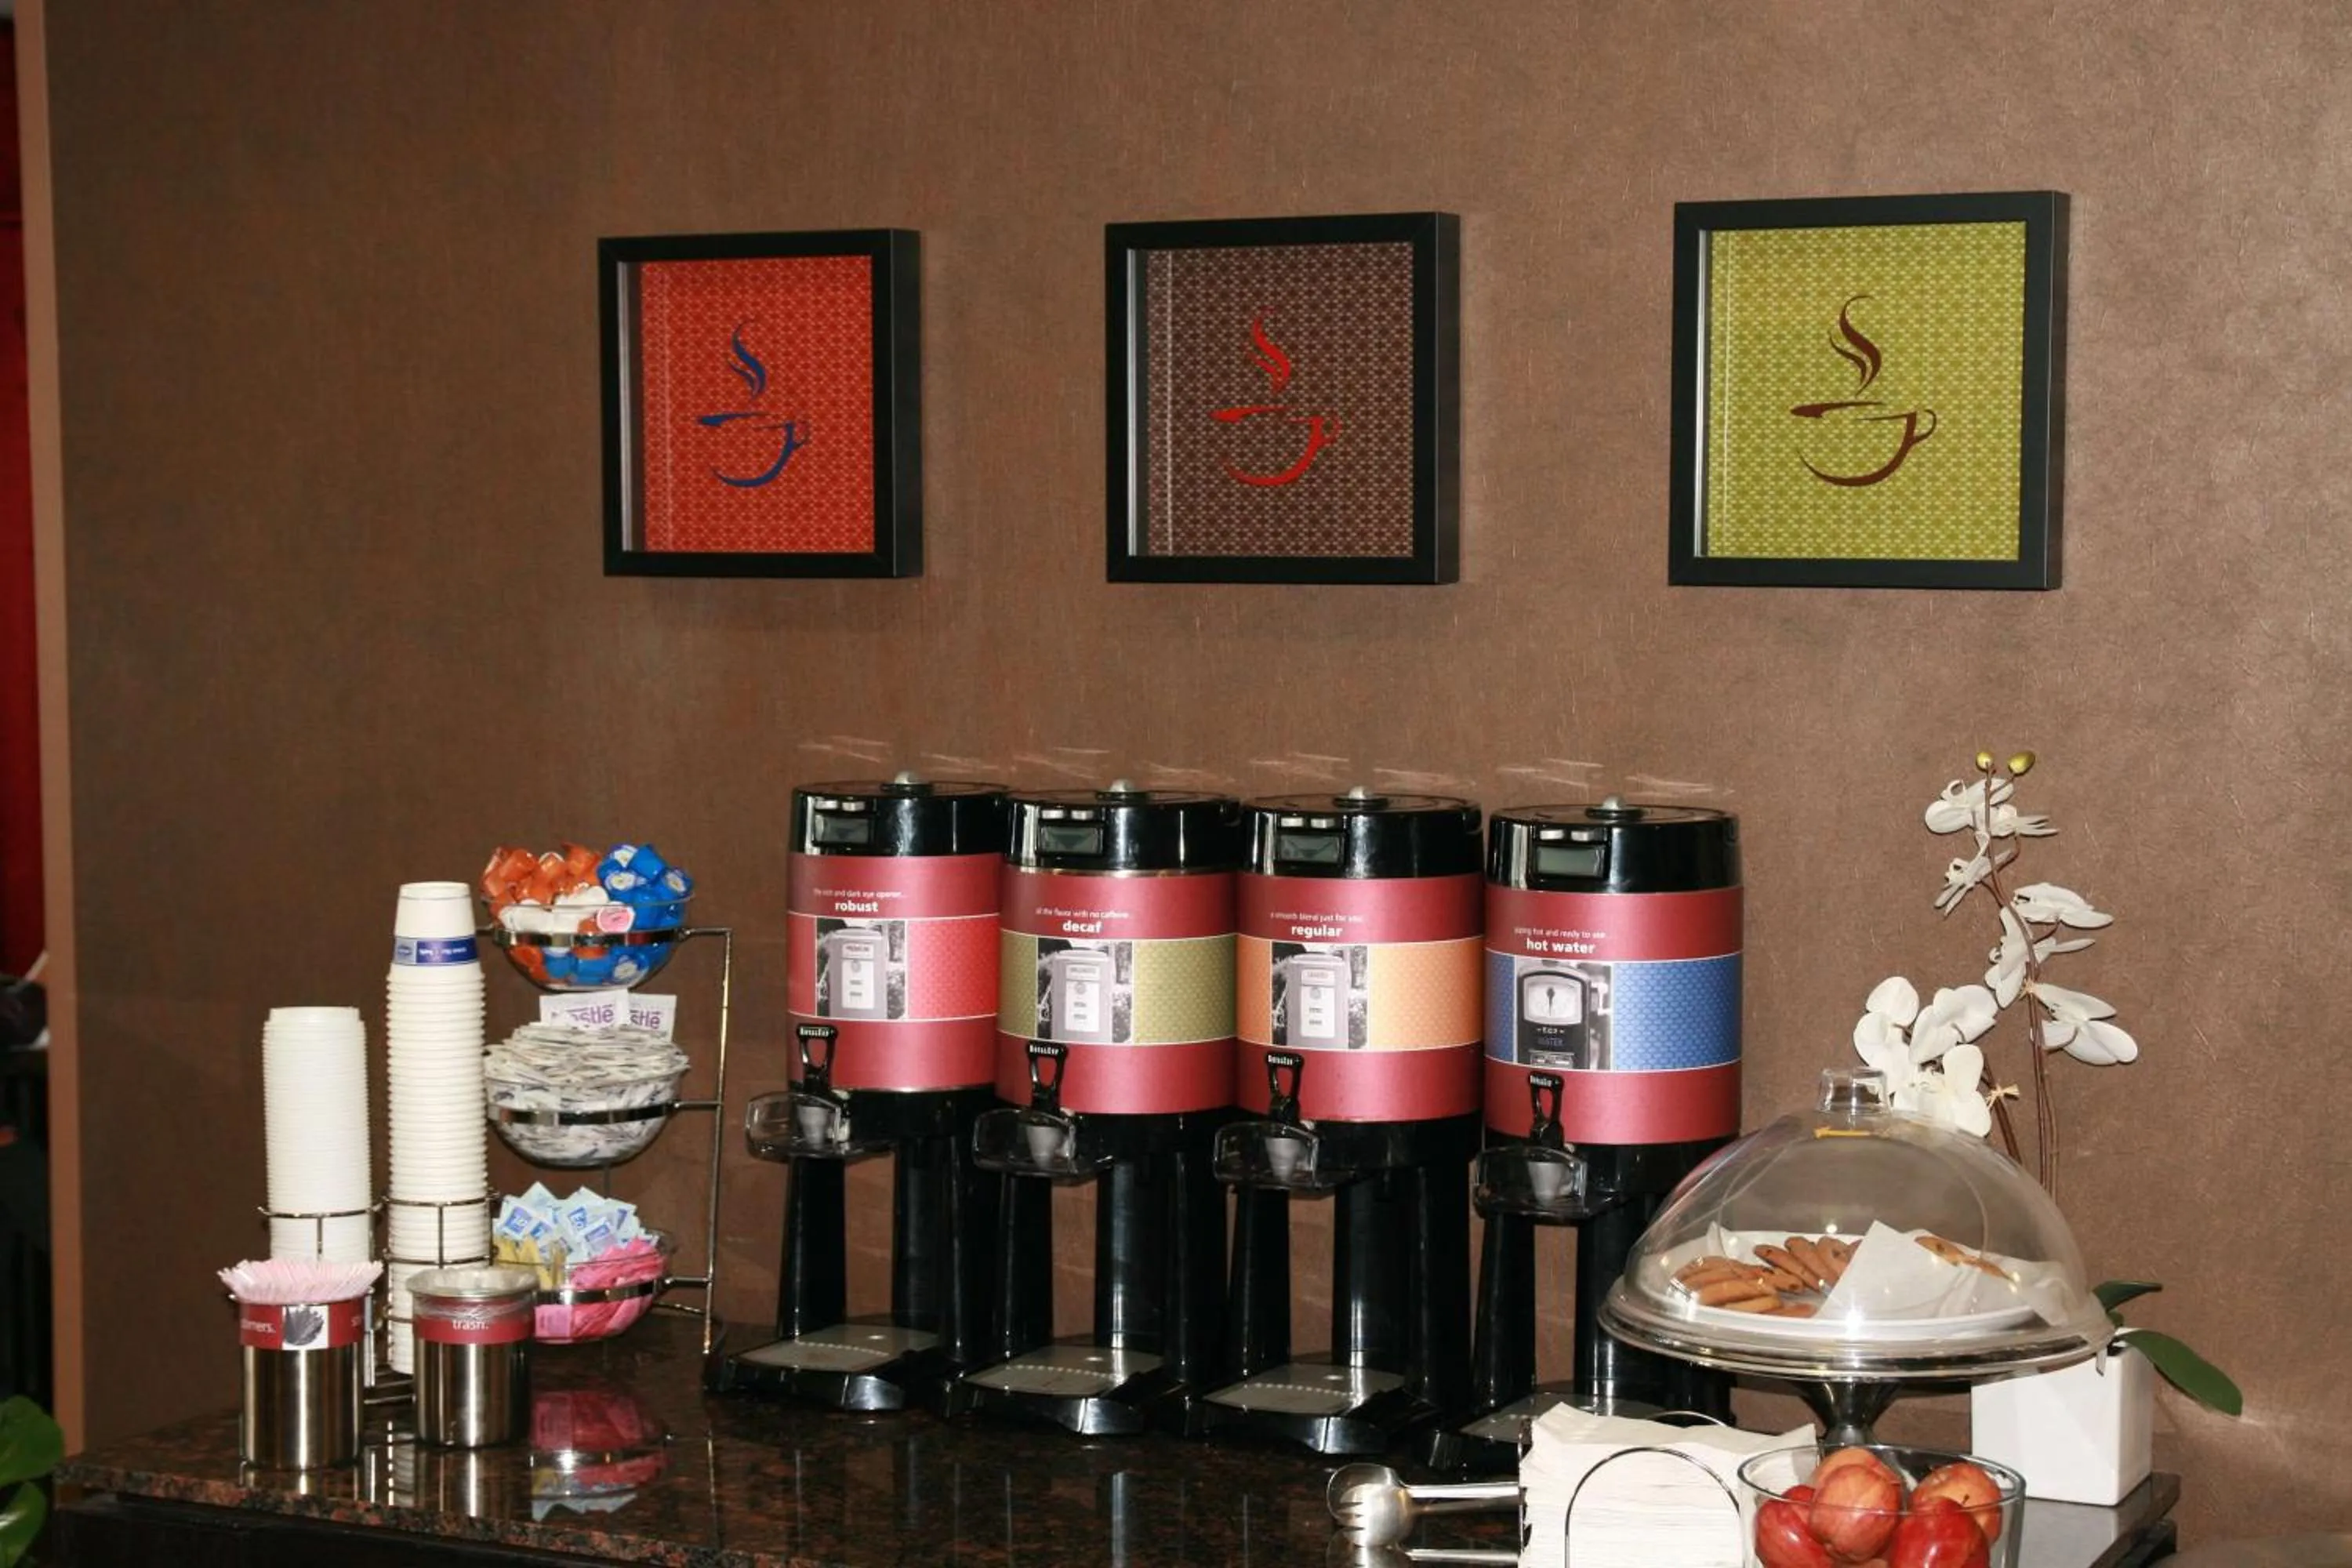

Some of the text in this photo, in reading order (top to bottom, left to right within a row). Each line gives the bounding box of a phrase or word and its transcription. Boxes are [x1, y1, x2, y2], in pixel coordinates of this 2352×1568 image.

[834, 899, 879, 913] robust
[1062, 920, 1102, 933] decaf
[1291, 924, 1343, 938] regular
[1526, 937, 1596, 953] hot water
